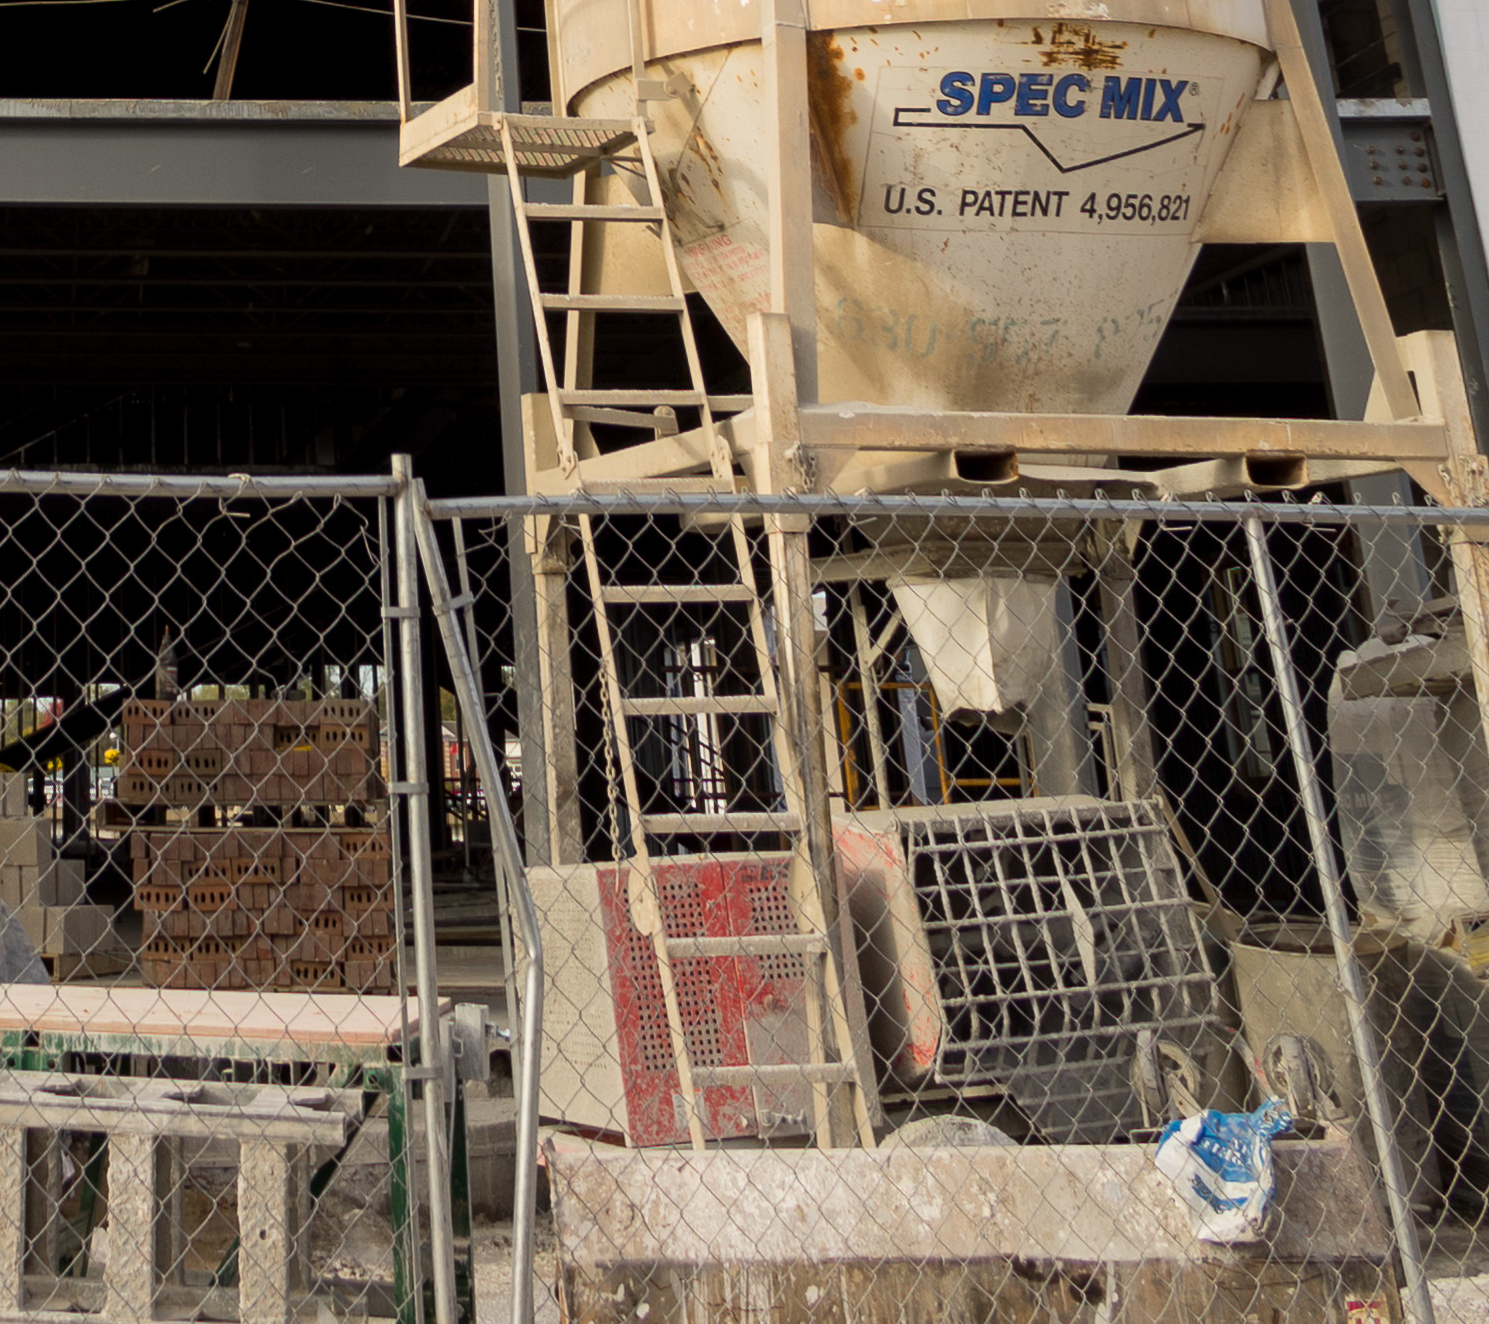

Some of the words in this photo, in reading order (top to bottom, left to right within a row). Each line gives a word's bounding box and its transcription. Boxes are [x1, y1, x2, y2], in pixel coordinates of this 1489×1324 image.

[936, 70, 1090, 119] SPEC
[1100, 75, 1189, 123] MIX
[883, 186, 943, 216] U.S.
[959, 190, 1070, 219] PATENT
[1079, 192, 1191, 225] 4,956,821
